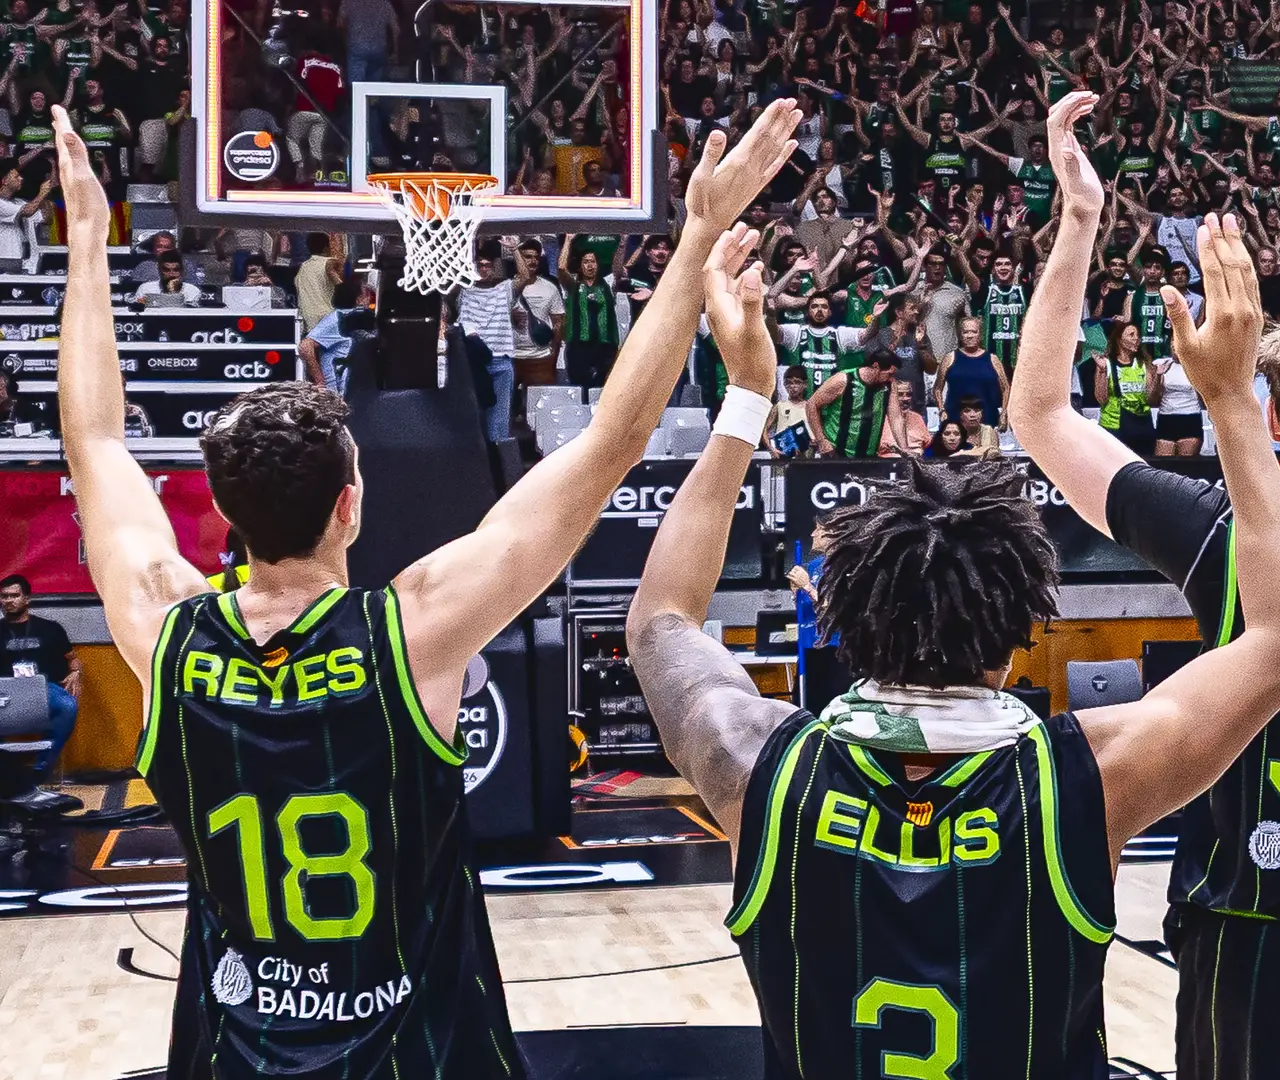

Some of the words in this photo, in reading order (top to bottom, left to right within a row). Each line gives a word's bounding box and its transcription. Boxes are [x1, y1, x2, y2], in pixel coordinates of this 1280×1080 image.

[233, 155, 272, 165] endesa
[1002, 317, 1010, 331] 9
[1147, 319, 1155, 332] 9
[191, 329, 243, 344] acb
[148, 358, 198, 368] ONEBOX
[224, 361, 271, 379] acb
[814, 371, 822, 385] 9
[183, 646, 368, 707] REYES
[815, 788, 1001, 868] ELLIS
[207, 792, 377, 943] 18
[257, 956, 303, 984] City
[309, 962, 330, 985] of
[257, 972, 413, 1022] BADALONA
